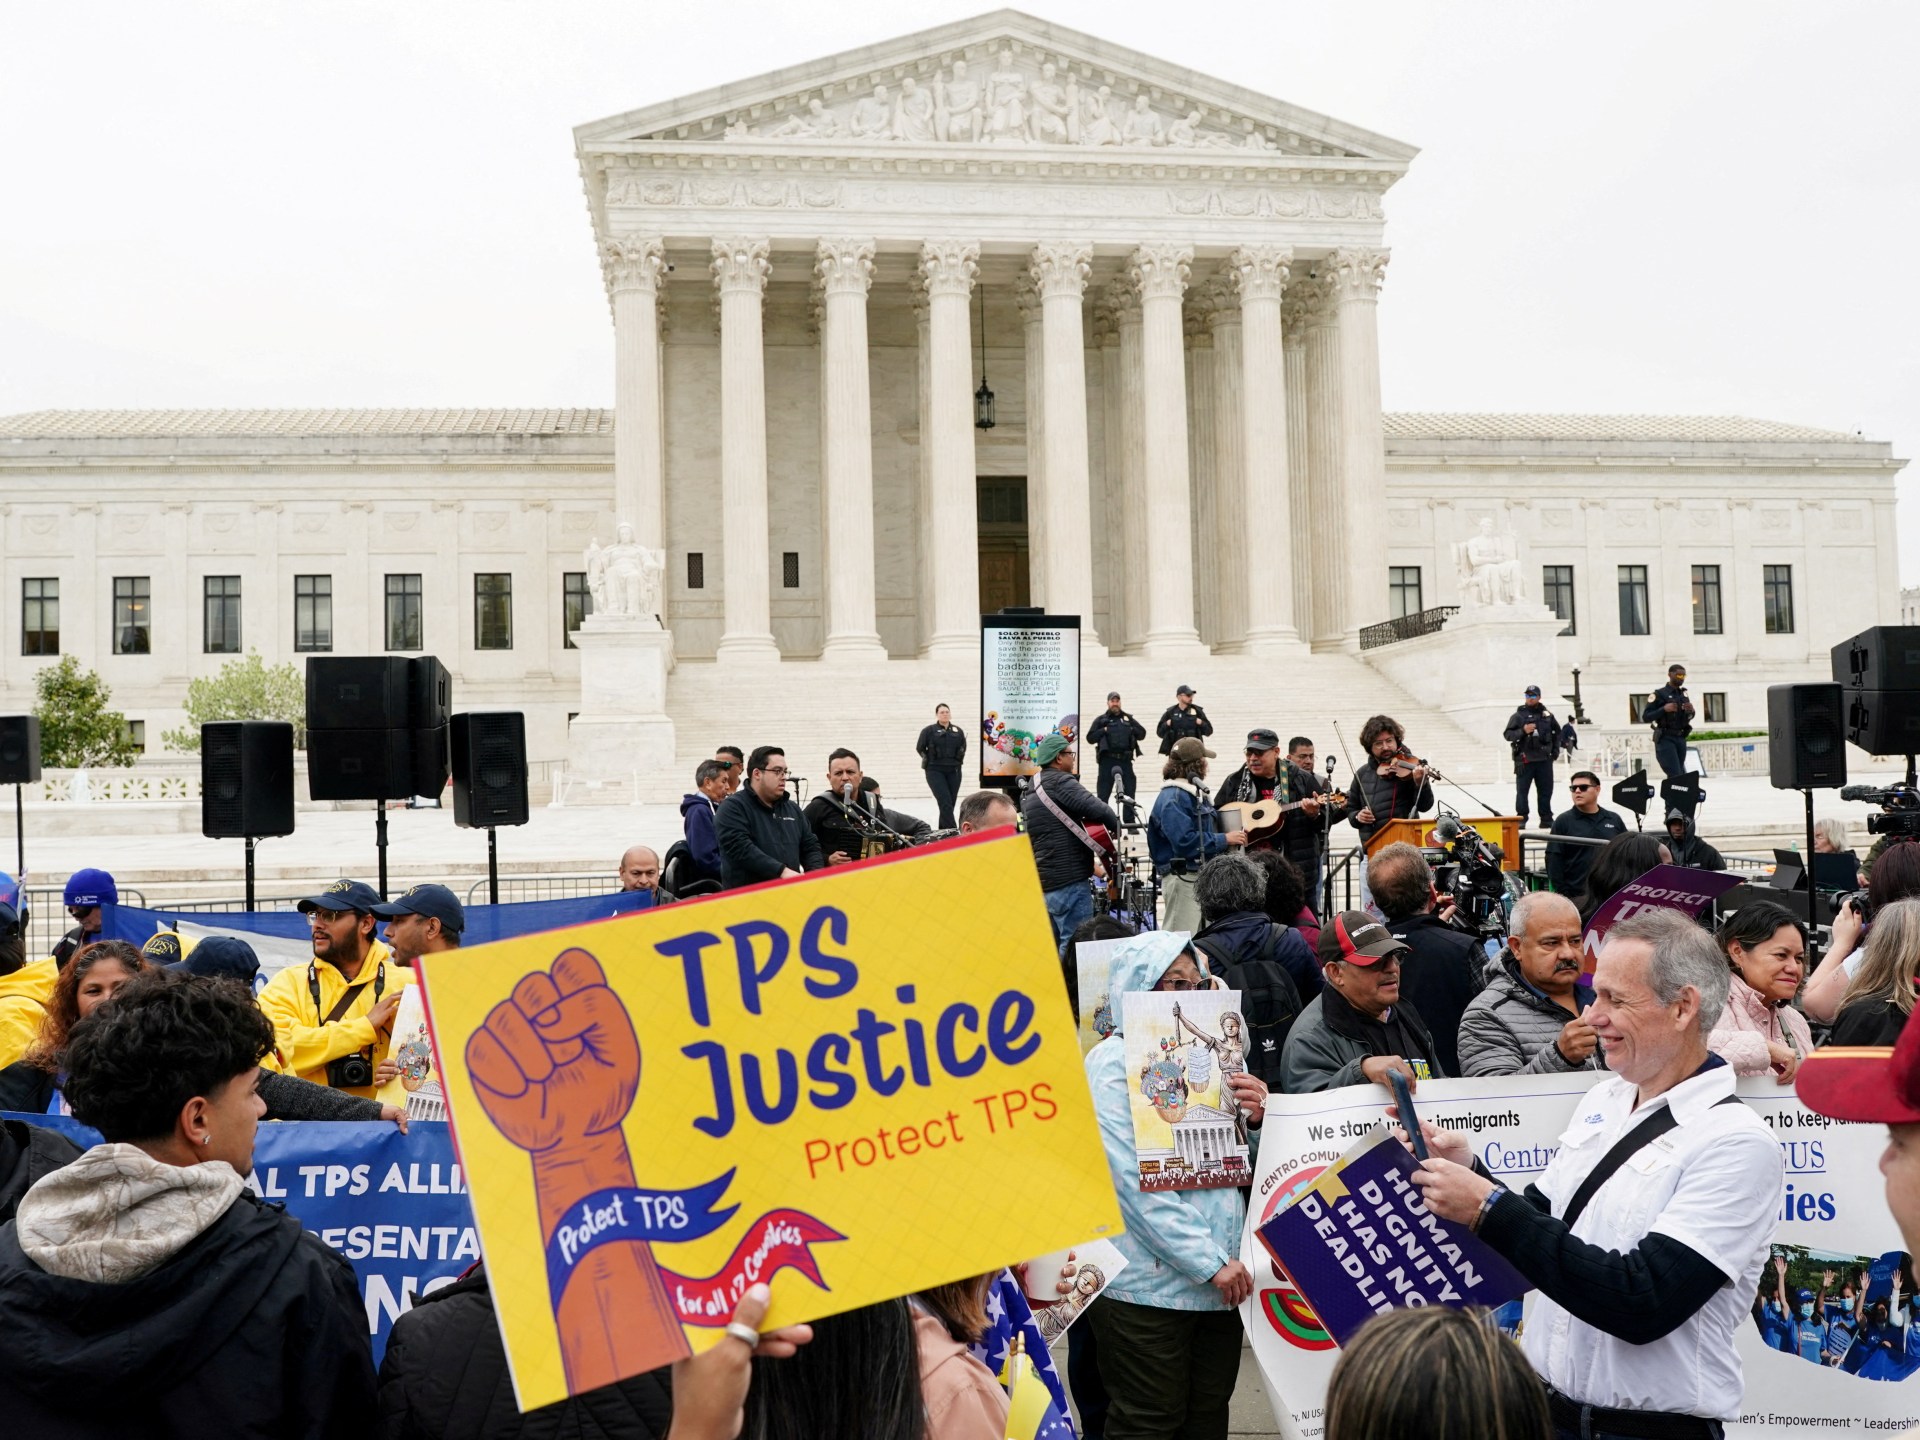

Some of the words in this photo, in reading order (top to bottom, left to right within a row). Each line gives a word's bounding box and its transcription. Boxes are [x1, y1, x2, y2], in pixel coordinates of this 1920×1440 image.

[997, 663, 1060, 671] badbaadiya
[1622, 884, 1711, 906] PROTECT
[654, 905, 859, 1027] TPS
[681, 984, 1042, 1138] Justice
[804, 1109, 964, 1179] Protect
[973, 1082, 1058, 1135] TPS
[1308, 1126, 1335, 1142] We
[1436, 1110, 1520, 1133] immigrants
[1778, 1111, 1794, 1128] to
[1797, 1110, 1831, 1130] keep
[1780, 1140, 1825, 1169] US
[299, 1163, 371, 1197] TPS
[378, 1162, 468, 1195] ALLI
[1260, 1158, 1298, 1195] CENTRO
[1779, 1184, 1836, 1222] ies
[557, 1193, 629, 1265] Protect
[633, 1195, 689, 1230] TPS
[1358, 1179, 1462, 1303] DIGNITY
[1384, 1167, 1484, 1289] HUMAN
[676, 1284, 703, 1316] for
[705, 1287, 729, 1317] all
[743, 1220, 803, 1282] Countries
[1337, 1200, 1393, 1266] HAS
[1385, 1265, 1429, 1310] NO
[1301, 1410, 1310, 1420] NJ
[1768, 1413, 1851, 1428] Empowerment
